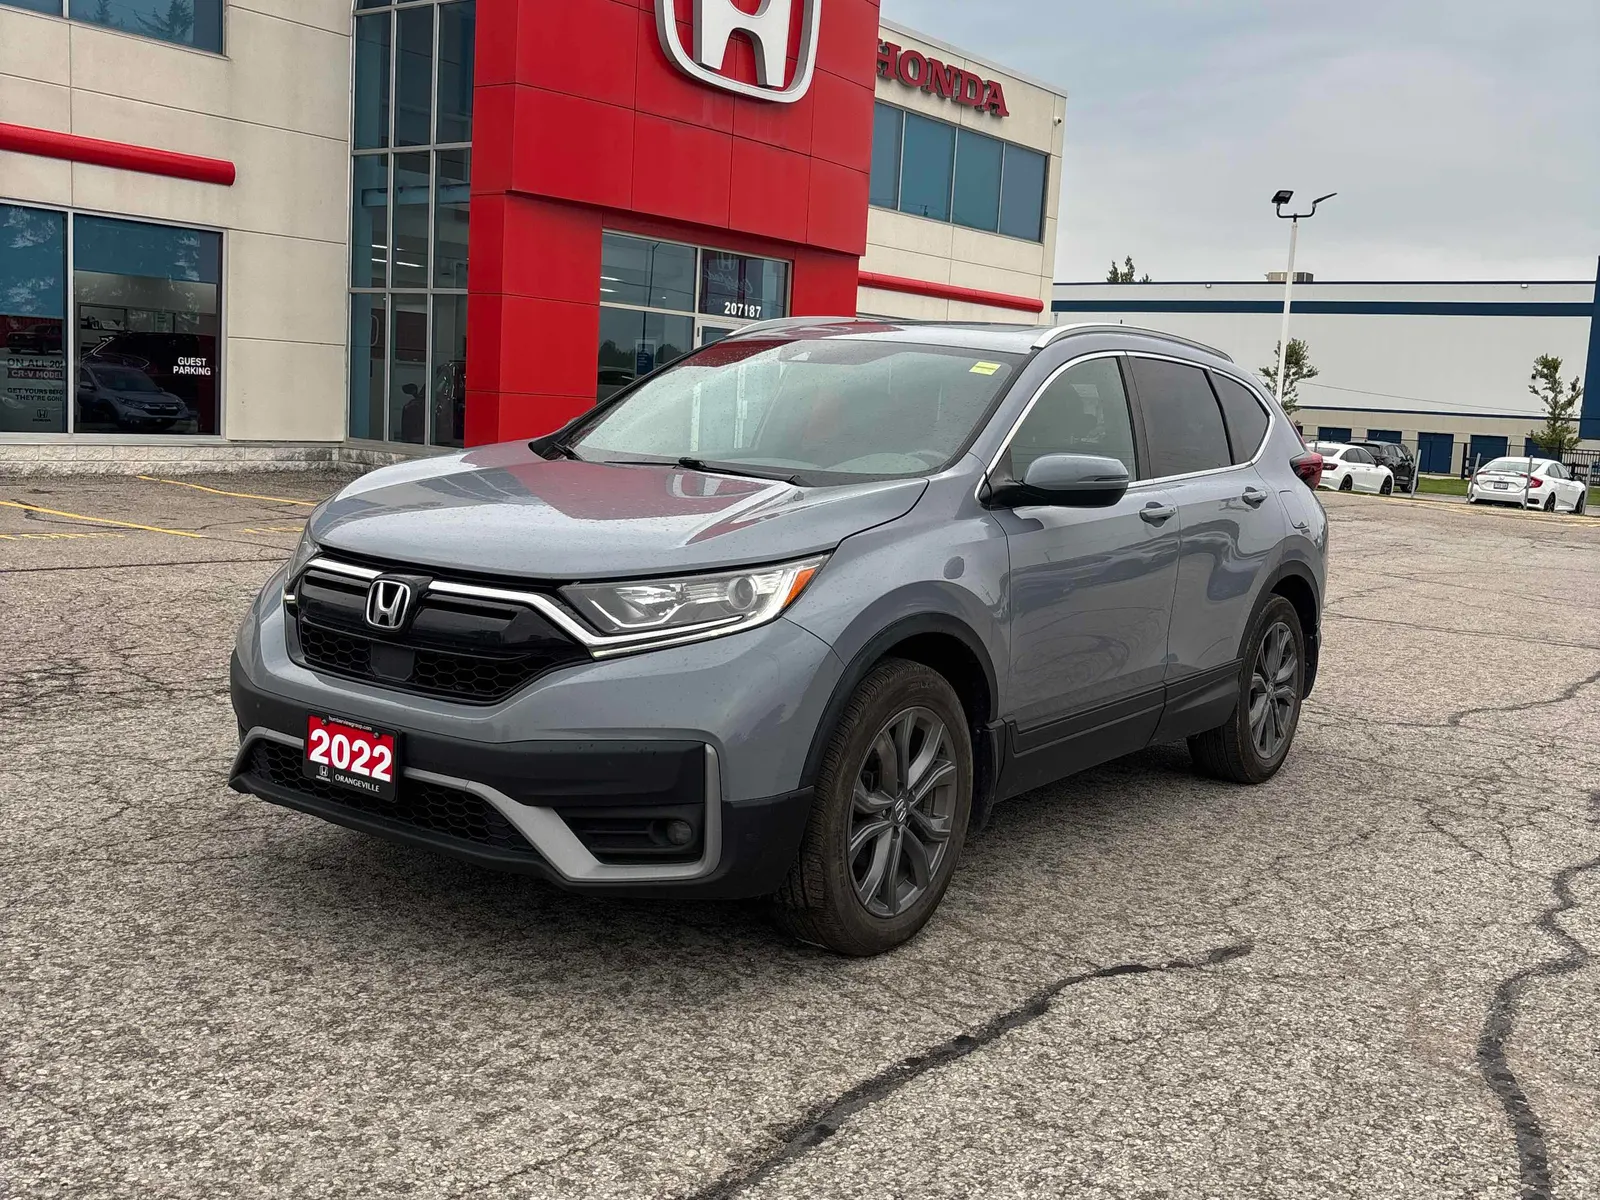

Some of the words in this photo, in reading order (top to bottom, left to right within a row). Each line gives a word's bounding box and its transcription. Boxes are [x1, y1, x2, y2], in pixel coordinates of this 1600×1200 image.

[876, 38, 1010, 117] HONDA
[723, 301, 762, 318] 207187
[7, 358, 24, 367] ON
[27, 359, 47, 368] ALL
[177, 356, 207, 366] GUEST
[172, 365, 211, 376] PARKING
[309, 728, 392, 782] 2022
[334, 773, 380, 793] ORANGEVILLE
